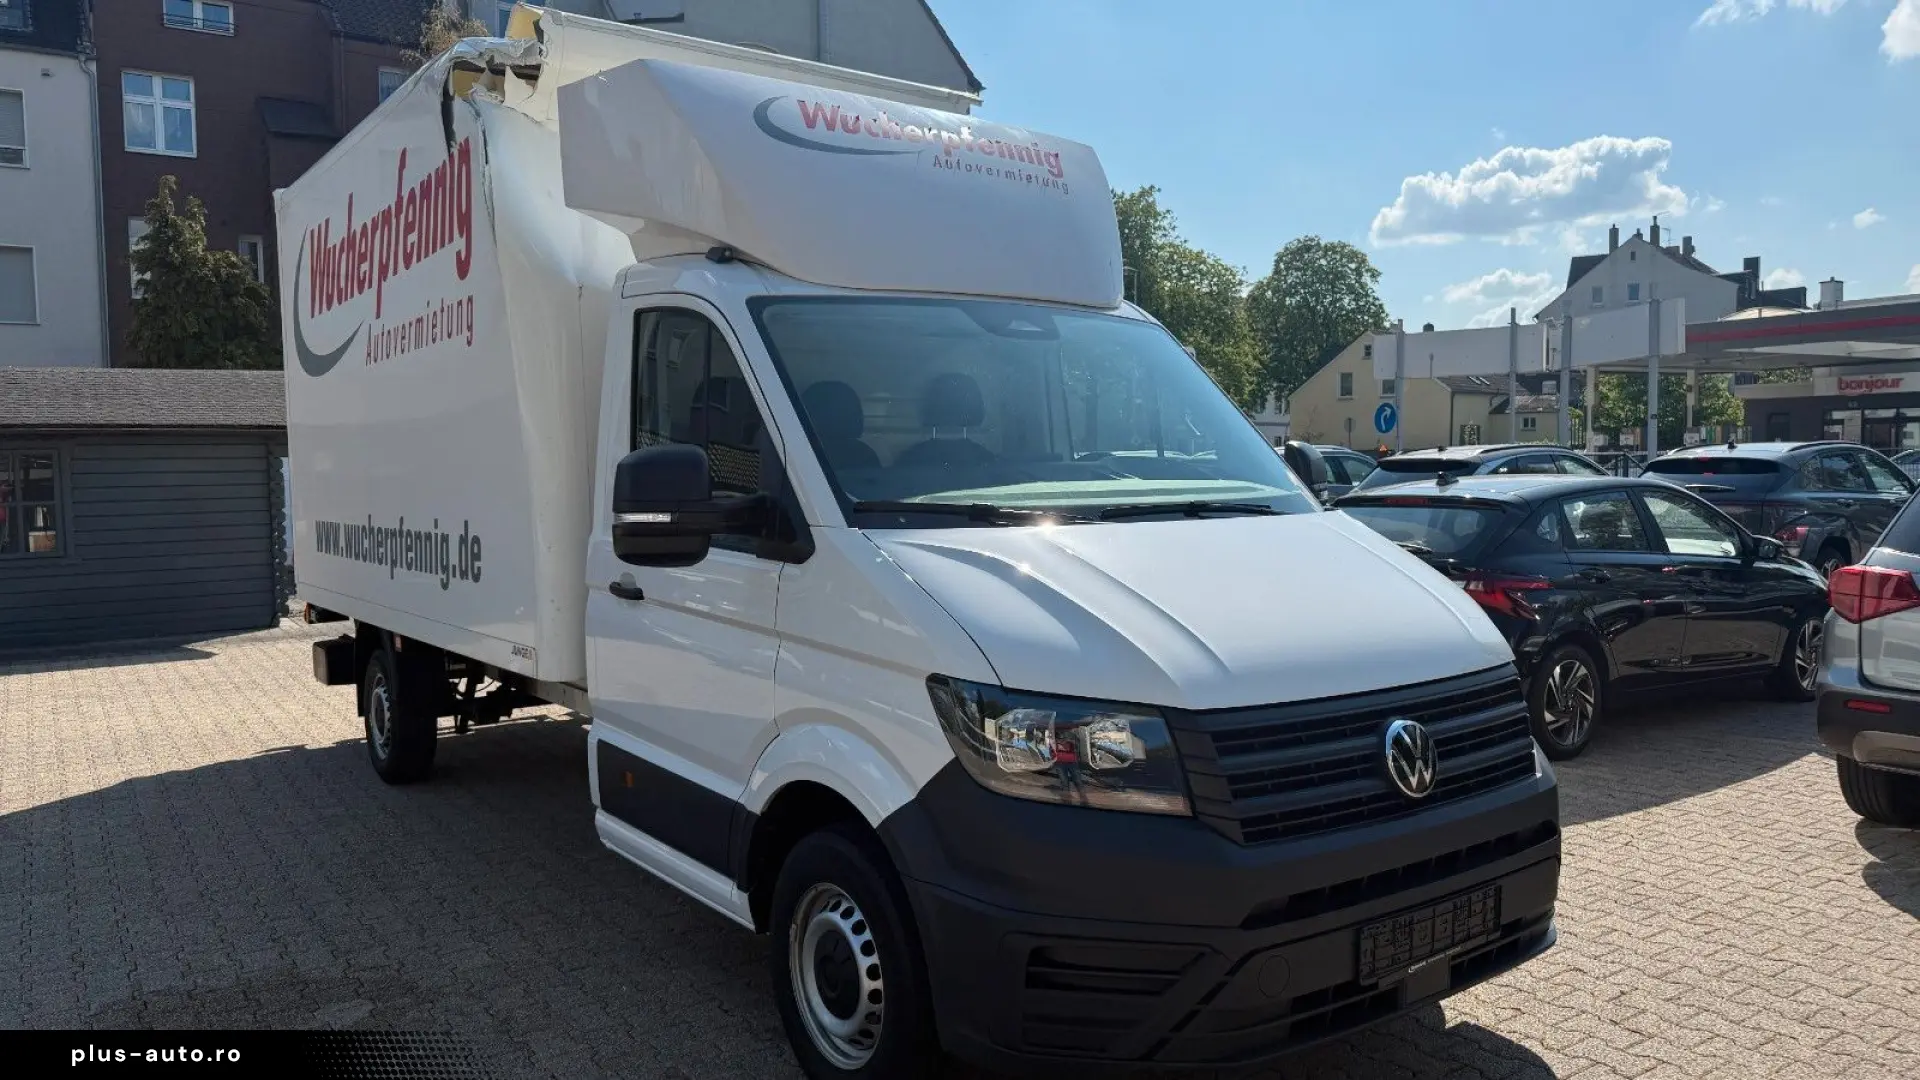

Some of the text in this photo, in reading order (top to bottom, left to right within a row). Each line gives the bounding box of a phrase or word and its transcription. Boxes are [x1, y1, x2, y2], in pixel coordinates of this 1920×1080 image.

[797, 99, 1063, 178] Wucherpfennig
[933, 154, 1069, 194] Autovermietung
[309, 136, 472, 319] Wucherpfennig
[365, 295, 473, 366] Autovermietung
[1837, 375, 1904, 392] bonjour
[315, 514, 481, 590] www.wucherpfennig.de
